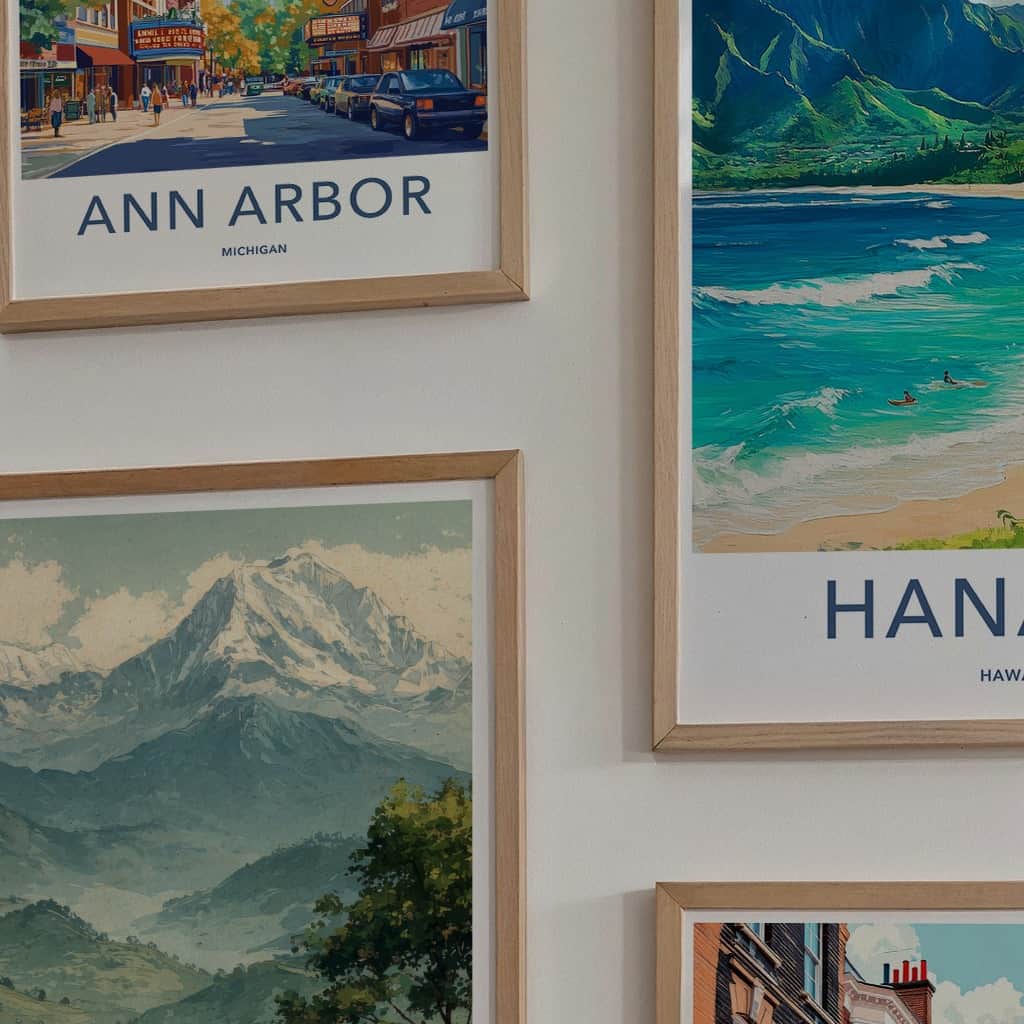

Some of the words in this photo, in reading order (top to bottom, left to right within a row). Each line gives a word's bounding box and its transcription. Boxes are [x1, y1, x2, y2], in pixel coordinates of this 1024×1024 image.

[77, 188, 205, 236] ANN
[228, 175, 432, 227] ARBOR
[221, 243, 287, 257] MICHIGAN
[826, 577, 1024, 640] HAN
